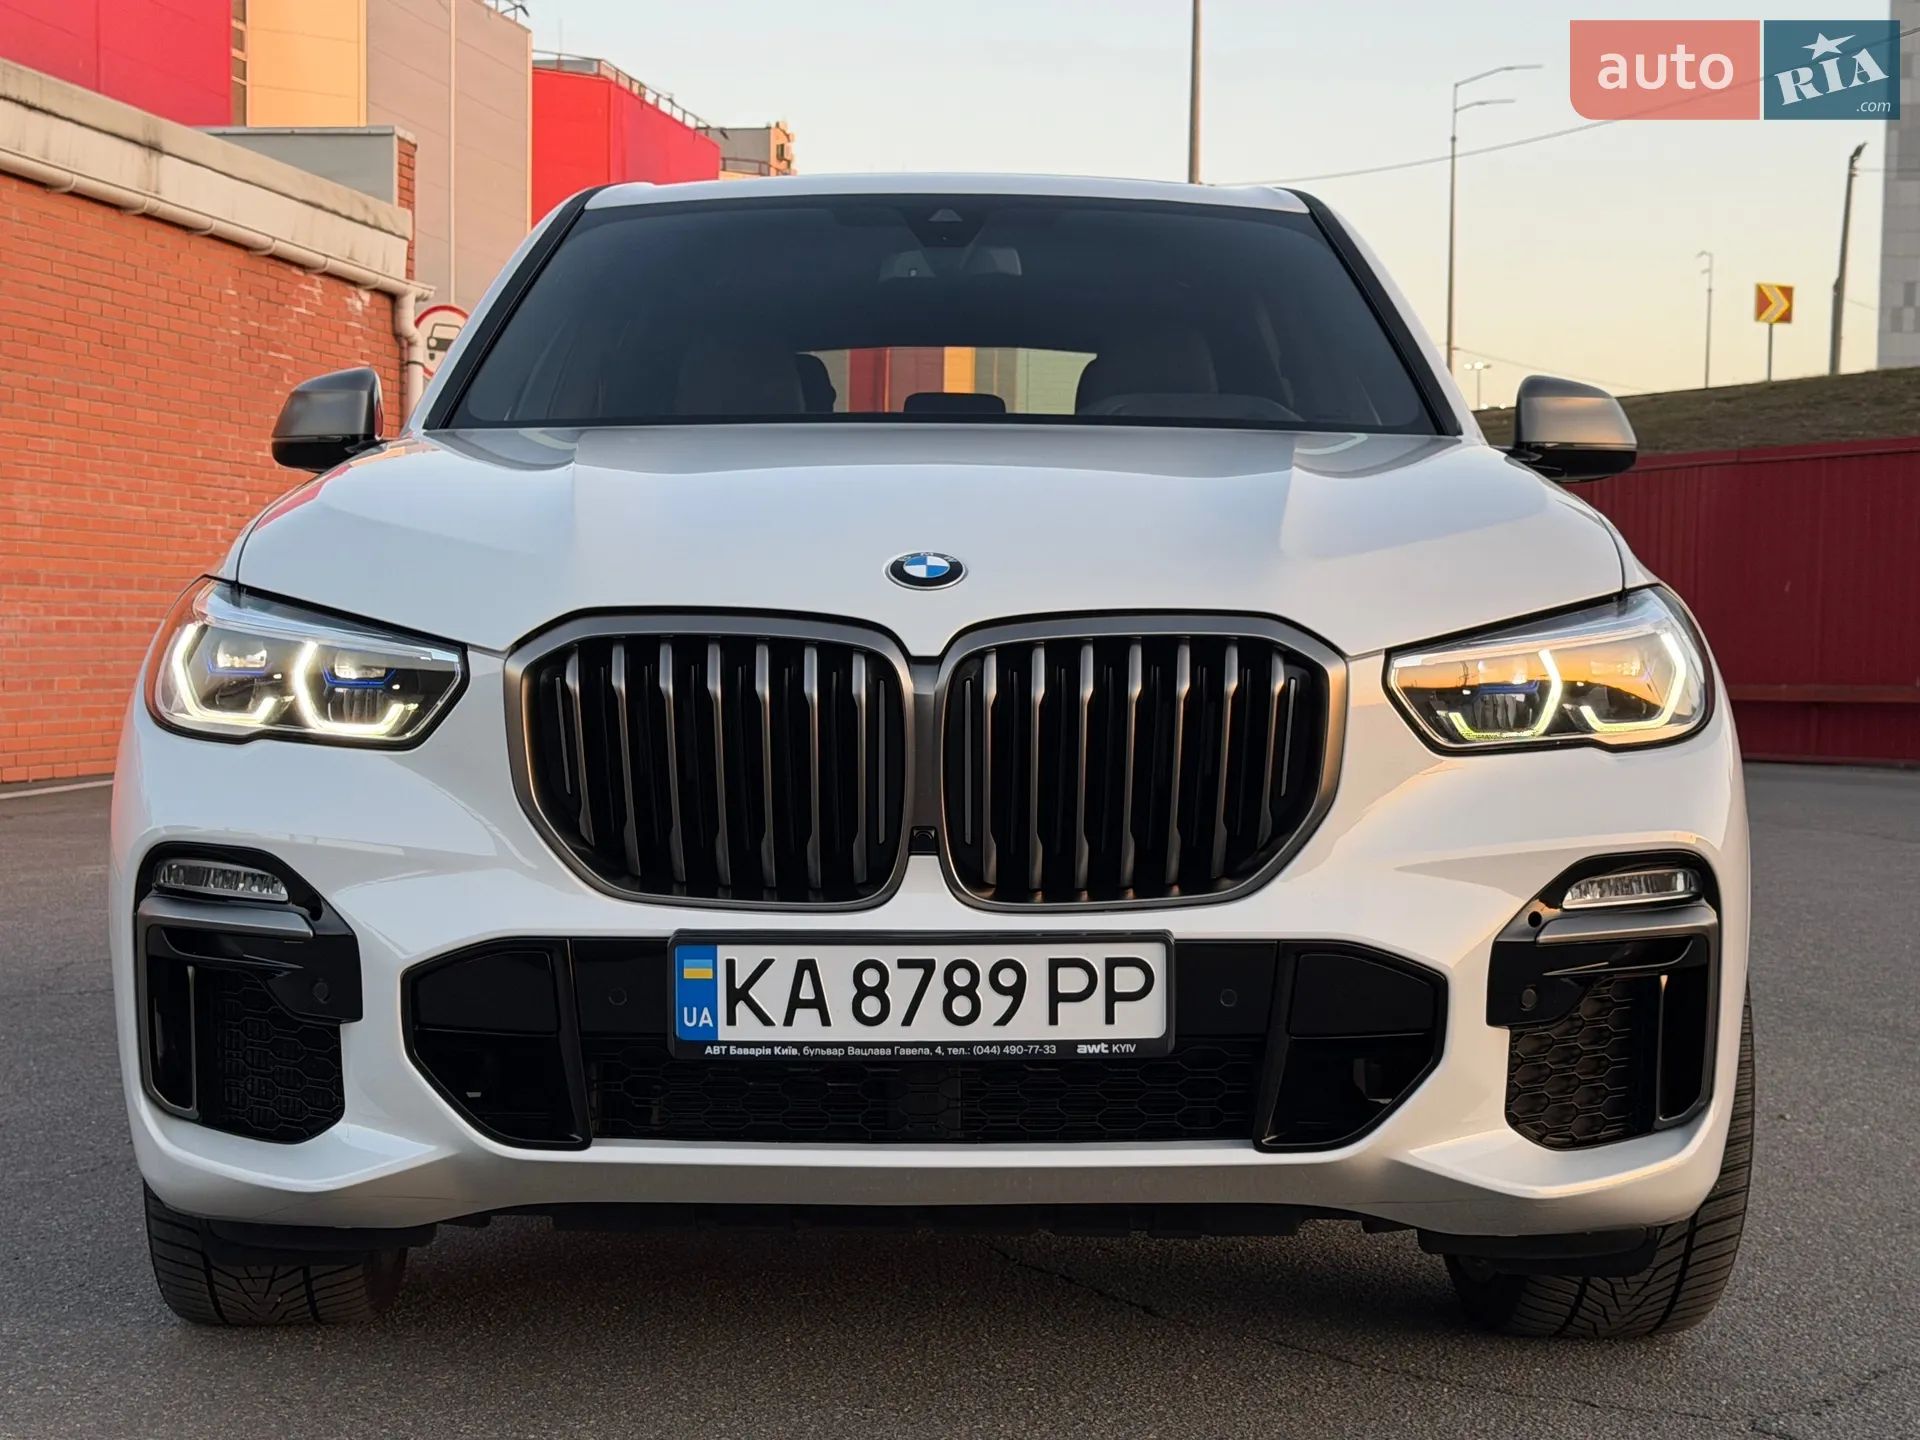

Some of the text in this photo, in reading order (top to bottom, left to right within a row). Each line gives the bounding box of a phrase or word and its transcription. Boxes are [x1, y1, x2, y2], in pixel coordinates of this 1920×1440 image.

[725, 957, 1156, 1027] KA 8789 PP
[683, 1006, 713, 1028] UA
[704, 1044, 1056, 1057] АВТ Баварія Київ, бульвар Вацлава Гавела, 4, тел.: (044) 490-77-33
[1112, 1043, 1136, 1054] KYIV
